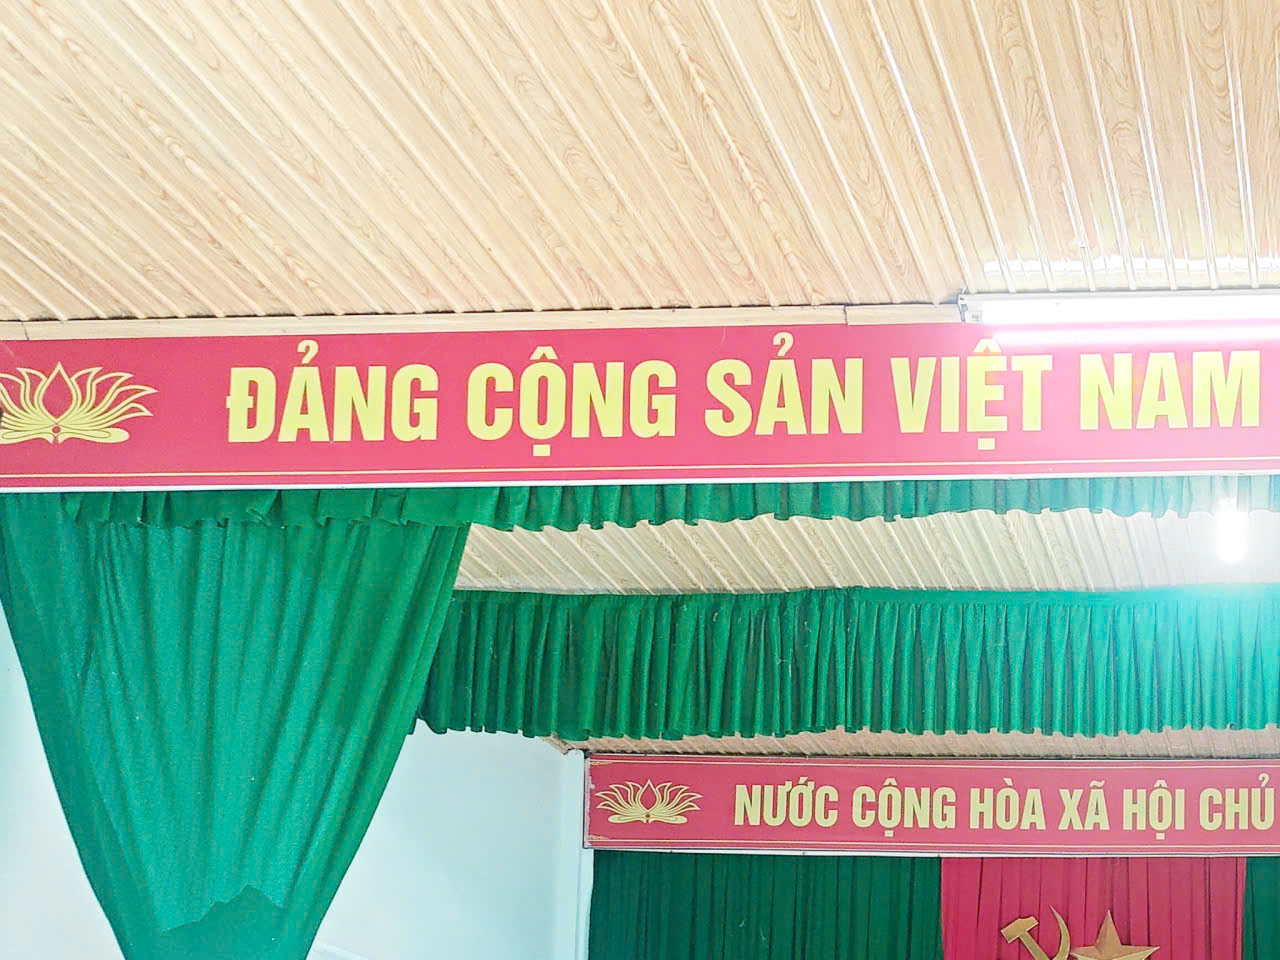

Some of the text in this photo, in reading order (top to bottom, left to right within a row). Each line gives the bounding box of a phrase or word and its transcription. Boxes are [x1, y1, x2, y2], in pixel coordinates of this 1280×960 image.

[227, 340, 438, 443] ĐẢNG
[467, 345, 677, 457] CỘNG
[704, 332, 866, 440] SẢN
[890, 339, 1053, 451] VIỆT
[1079, 350, 1261, 431] NAM
[734, 777, 839, 827] NƯỚC
[852, 778, 956, 837] CỘNG
[969, 779, 1046, 831] HÒA
[1058, 780, 1110, 831] XÃ
[1122, 780, 1185, 840] HỘI
[1199, 773, 1276, 831] CHỦ
